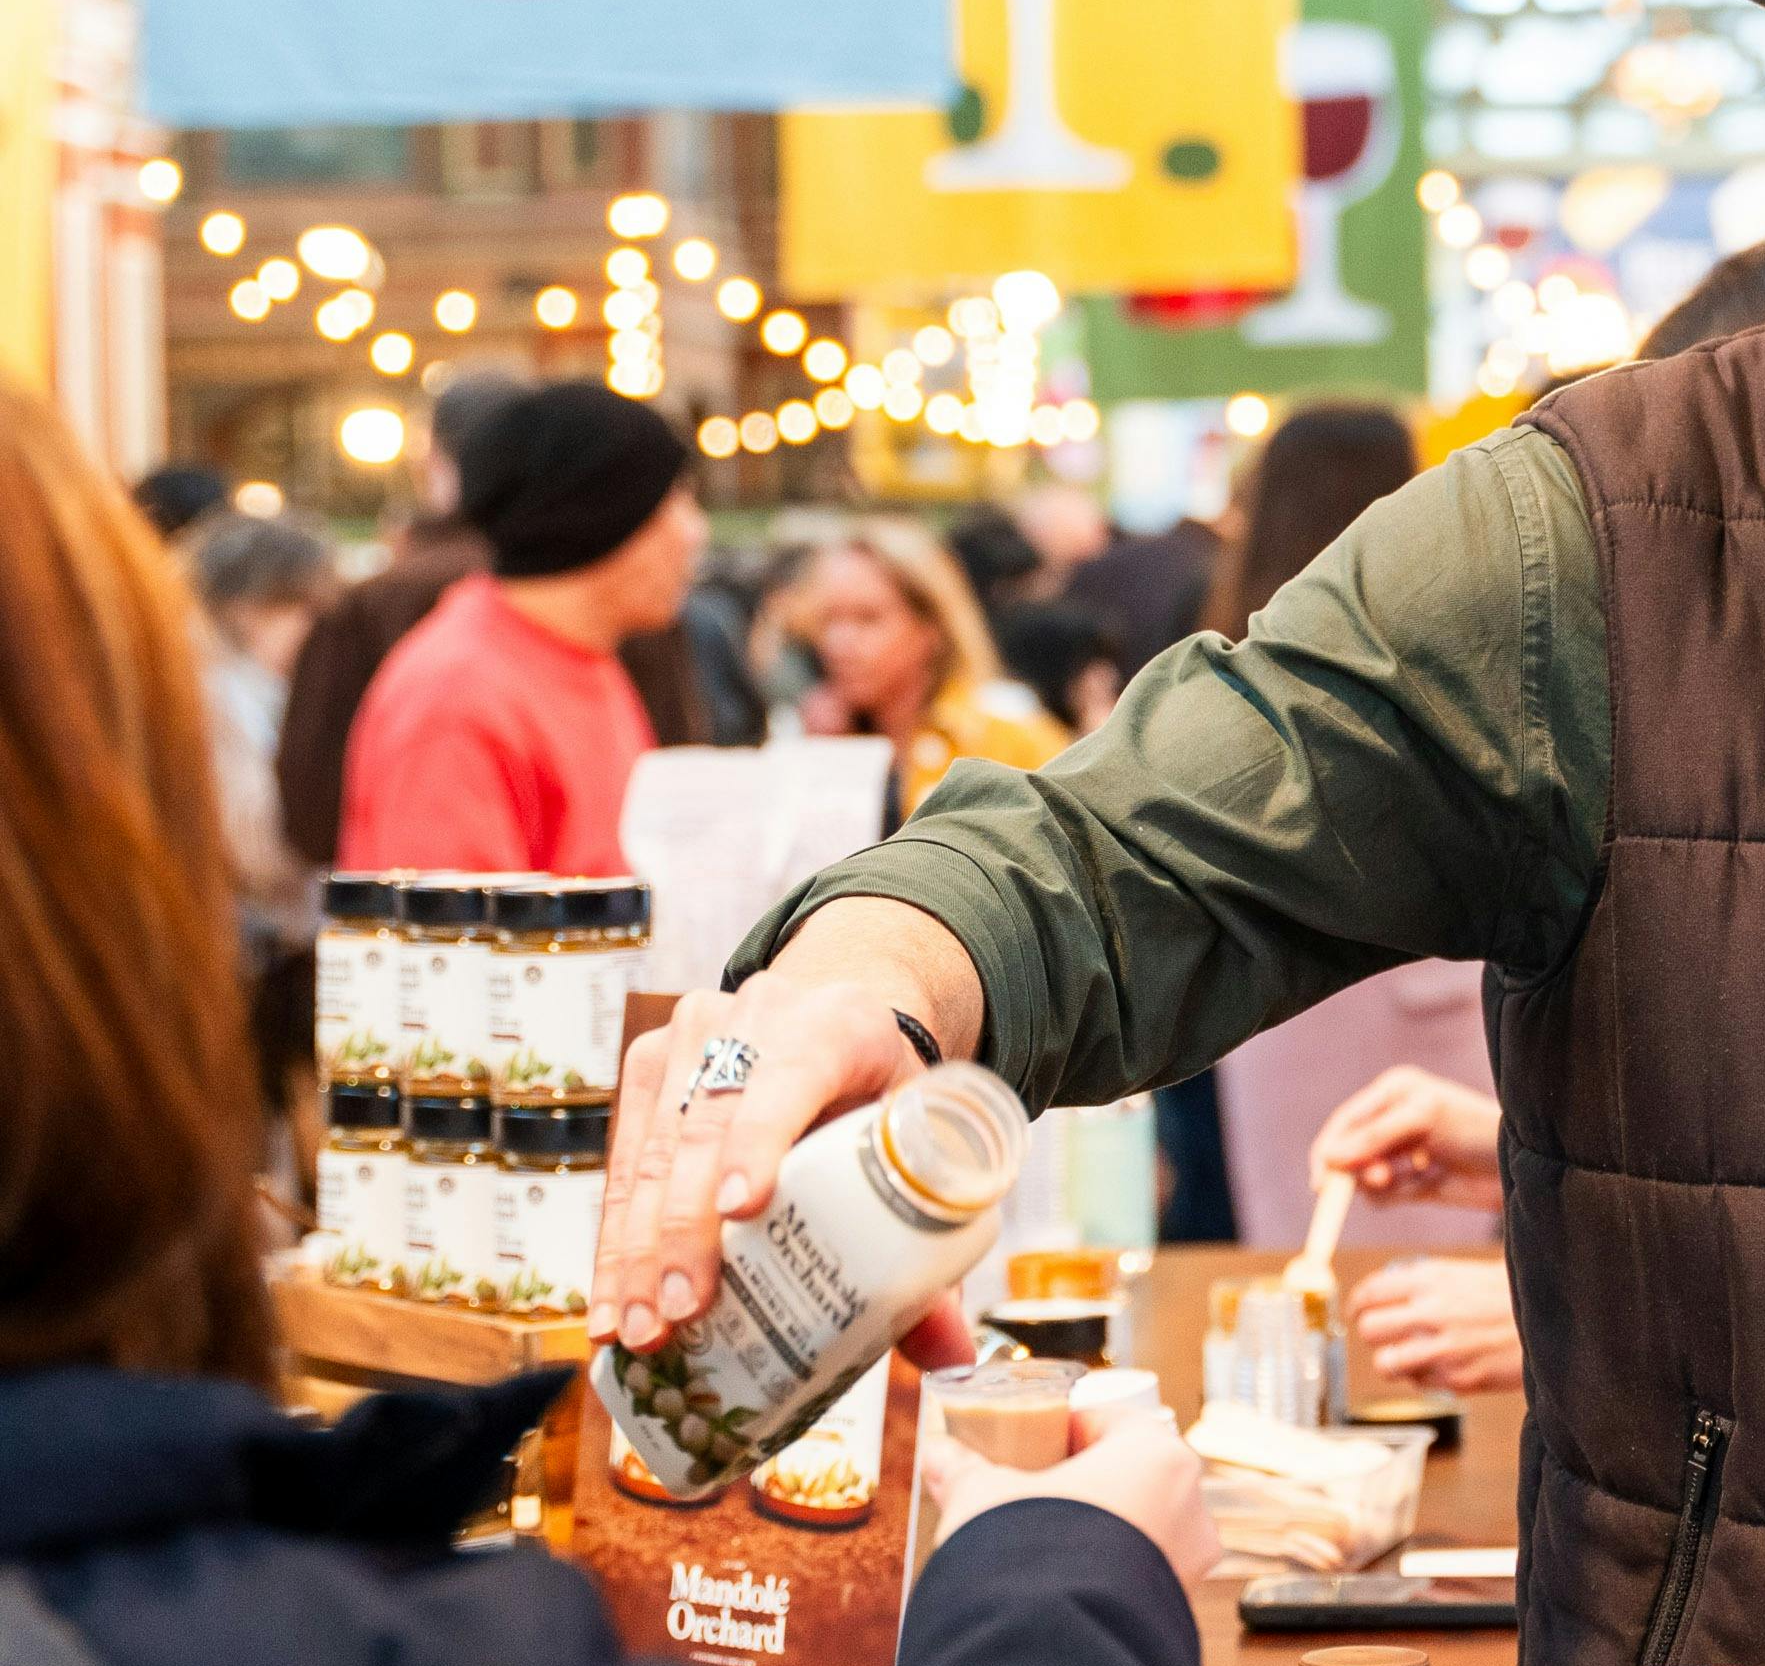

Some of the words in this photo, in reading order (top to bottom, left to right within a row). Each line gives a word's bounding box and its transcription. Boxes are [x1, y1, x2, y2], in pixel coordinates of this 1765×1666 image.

[767, 1218, 856, 1331] Orchard
[669, 1561, 790, 1615] Mandolé
[667, 1600, 786, 1655] Orchard
